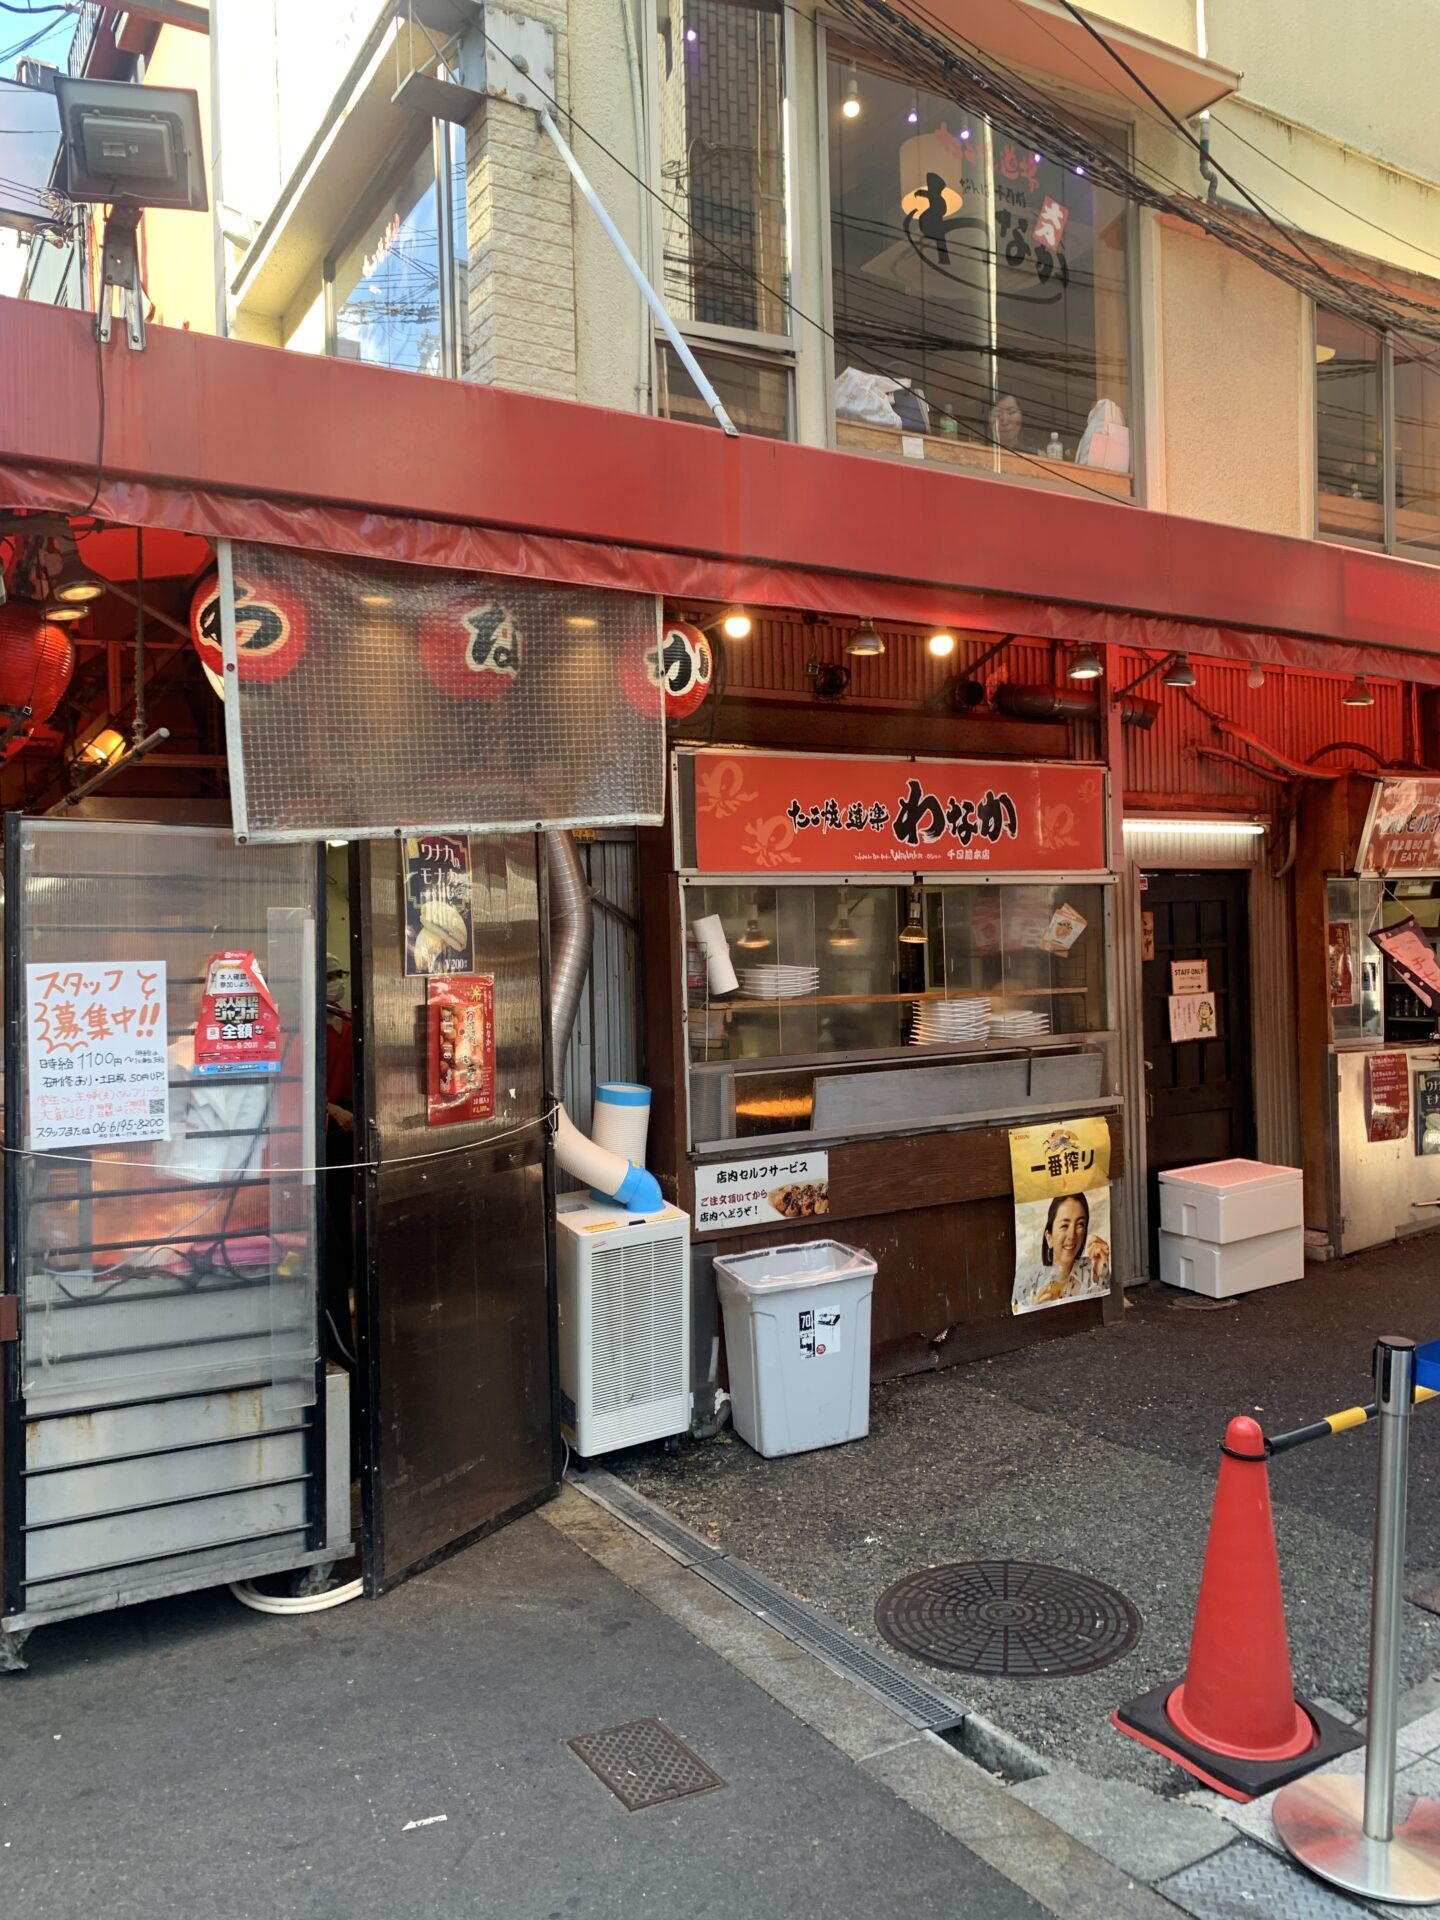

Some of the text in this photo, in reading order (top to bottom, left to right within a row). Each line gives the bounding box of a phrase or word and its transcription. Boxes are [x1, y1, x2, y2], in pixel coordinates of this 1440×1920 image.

[787, 778, 1018, 846] たこ焼道楽 わなか
[35, 971, 124, 1000] スタッフ
[221, 1023, 253, 1040] 全額
[716, 1161, 809, 1184] 店内セルフサービス
[1030, 1149, 1095, 1178] 一番搾り
[700, 1189, 768, 1207] ご注文頂いてから
